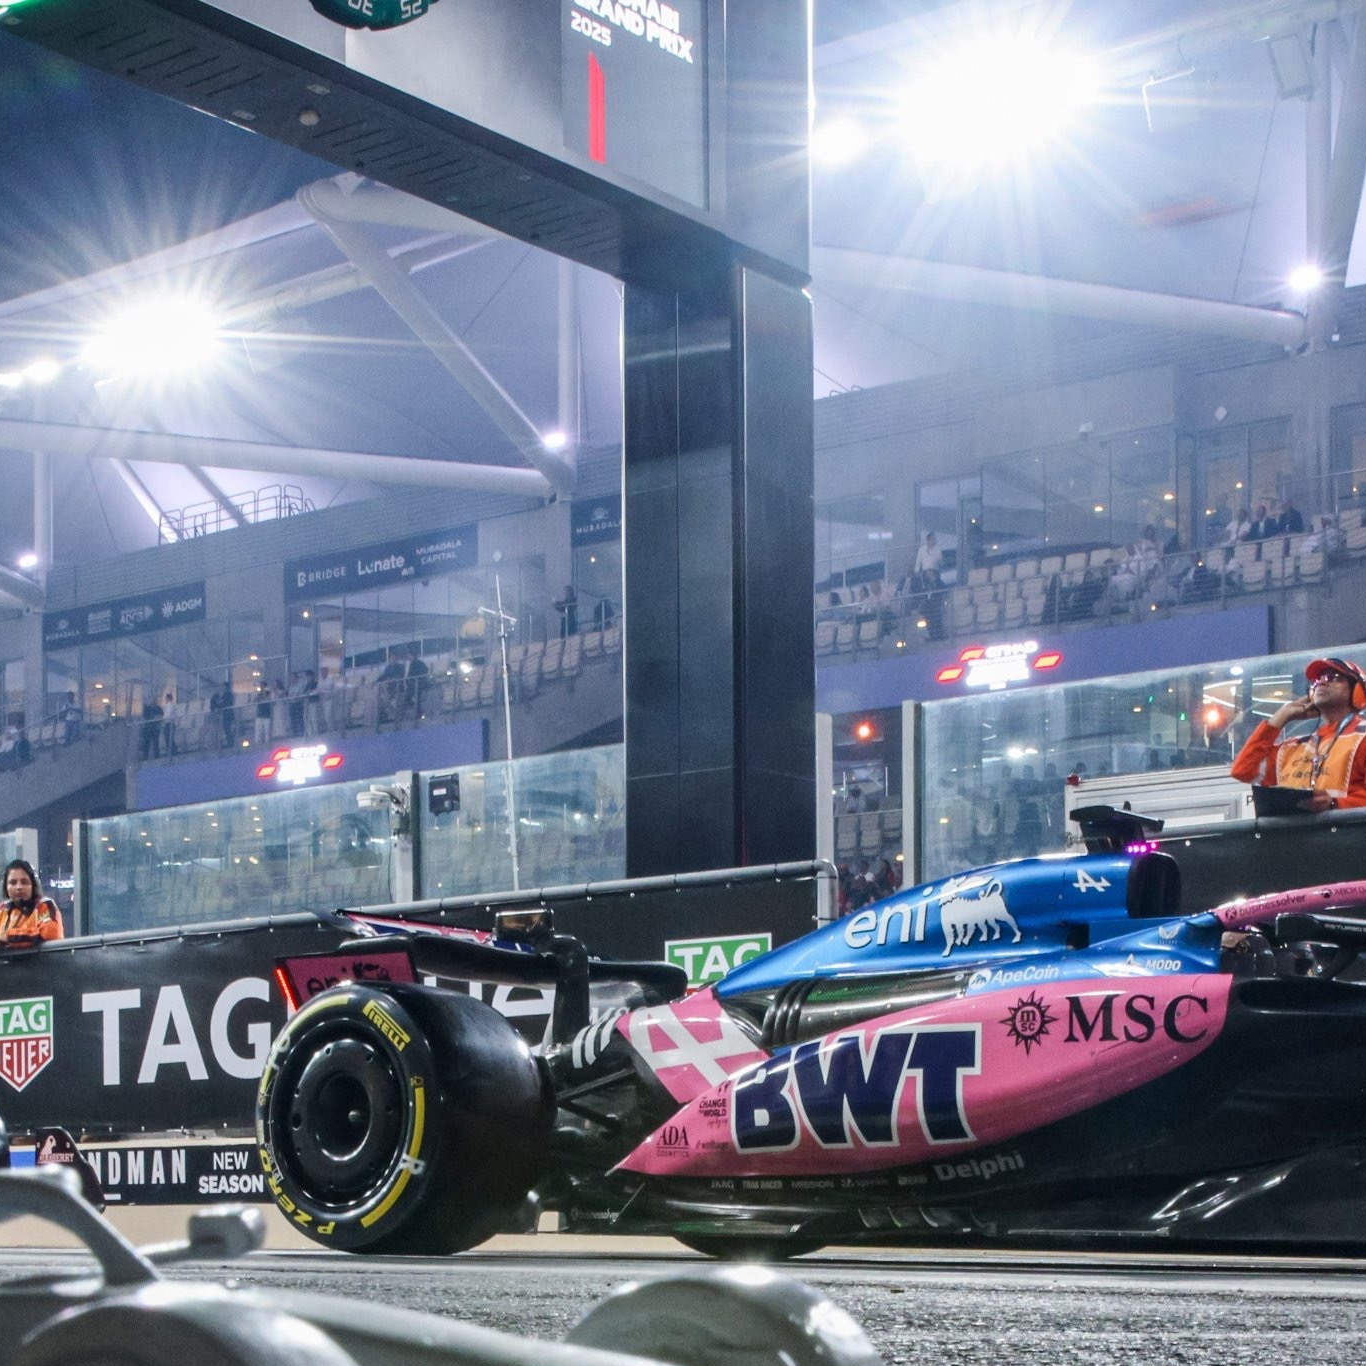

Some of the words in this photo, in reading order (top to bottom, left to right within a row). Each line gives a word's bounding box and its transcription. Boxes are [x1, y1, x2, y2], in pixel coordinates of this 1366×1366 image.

[570, 9, 612, 47] 2025
[646, 19, 694, 64] PRIX
[416, 538, 462, 555] MUBADALA
[420, 550, 458, 566] CAPITAL
[308, 565, 347, 583] BRIDGE
[175, 597, 202, 612] ADGM
[1238, 893, 1307, 918] businessolver
[843, 885, 935, 949] eni
[991, 965, 1060, 986] ApeCoin
[1145, 959, 1182, 972] MODO
[362, 999, 412, 1052] PIRELLI
[1063, 993, 1209, 1044] MSC
[81, 977, 271, 1086] TAG
[732, 1023, 983, 1154] BWT
[699, 1099, 727, 1109] CHANGE
[658, 1126, 690, 1147] ADA
[213, 1151, 239, 1170] NEW
[933, 1149, 1025, 1182] Delphi
[198, 1174, 264, 1194] SEASON
